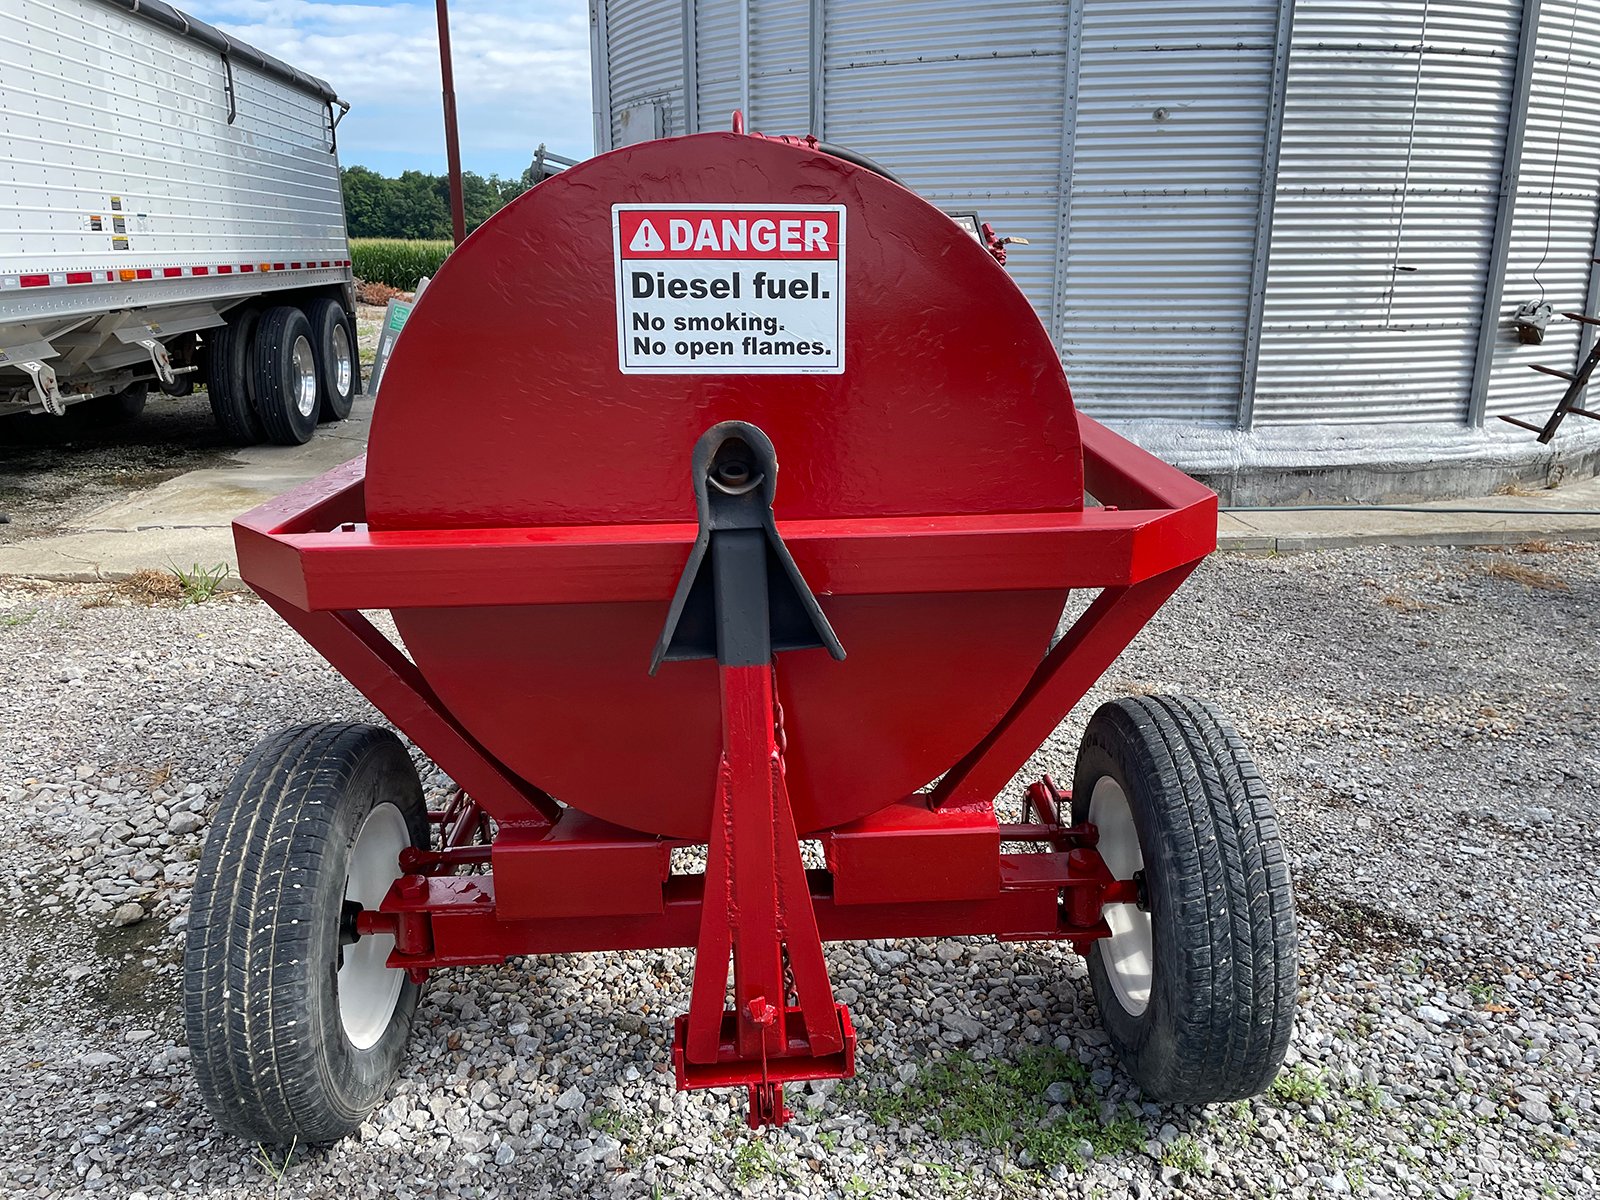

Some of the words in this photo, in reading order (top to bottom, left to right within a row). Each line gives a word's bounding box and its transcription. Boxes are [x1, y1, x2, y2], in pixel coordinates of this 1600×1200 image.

[669, 219, 830, 252] DANGER
[631, 271, 741, 299] Diesel
[752, 271, 830, 299] fuel.
[632, 312, 666, 331] No
[673, 312, 785, 335] smoking.
[633, 337, 667, 355] No
[674, 341, 734, 359] open
[742, 337, 832, 355] flames.
